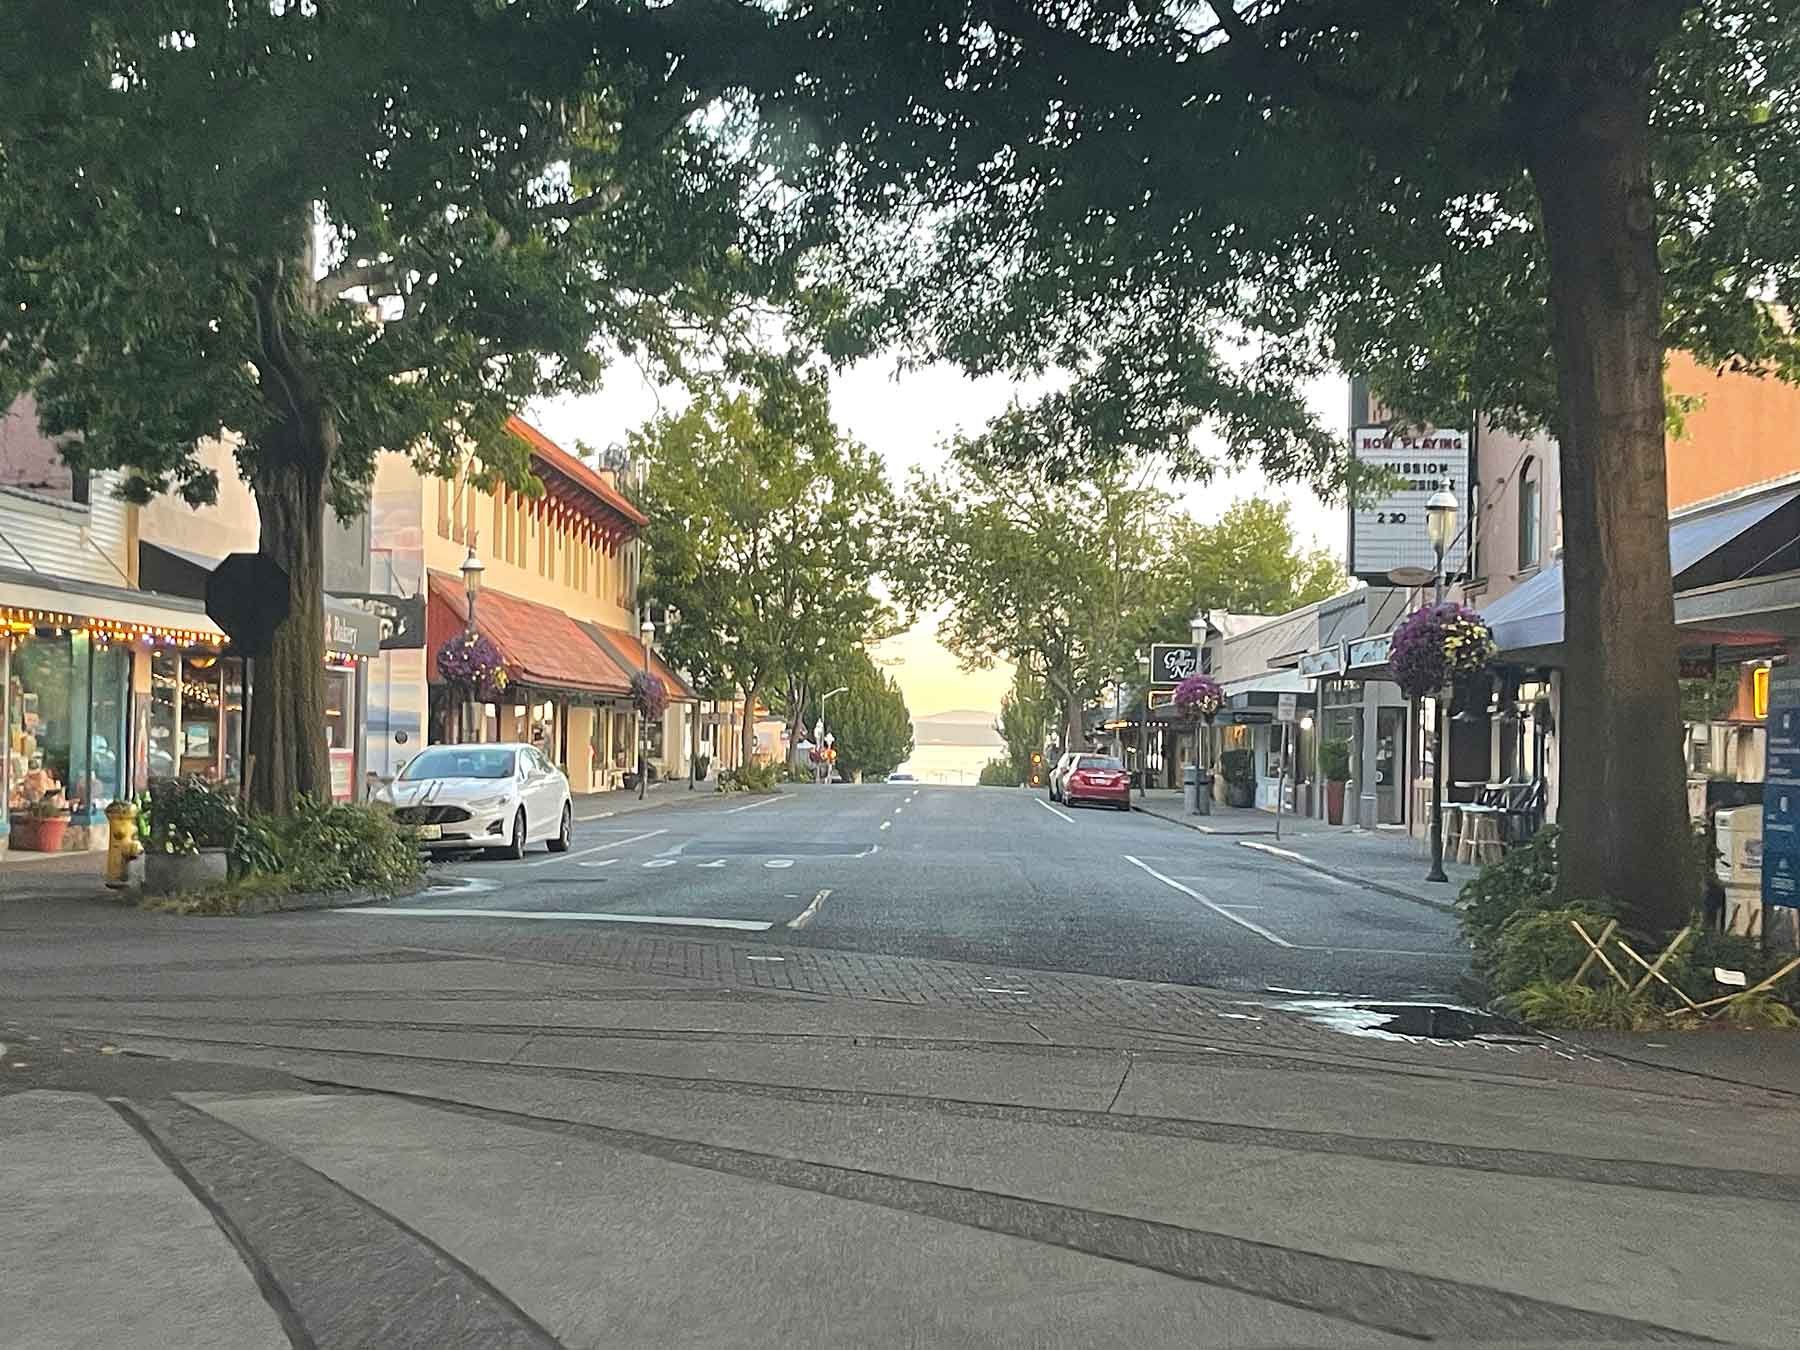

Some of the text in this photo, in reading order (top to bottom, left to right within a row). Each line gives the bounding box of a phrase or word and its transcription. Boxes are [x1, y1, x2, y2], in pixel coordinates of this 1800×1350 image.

[1363, 438, 1462, 449] NOW PLAYING
[1385, 463, 1448, 474] MISSION
